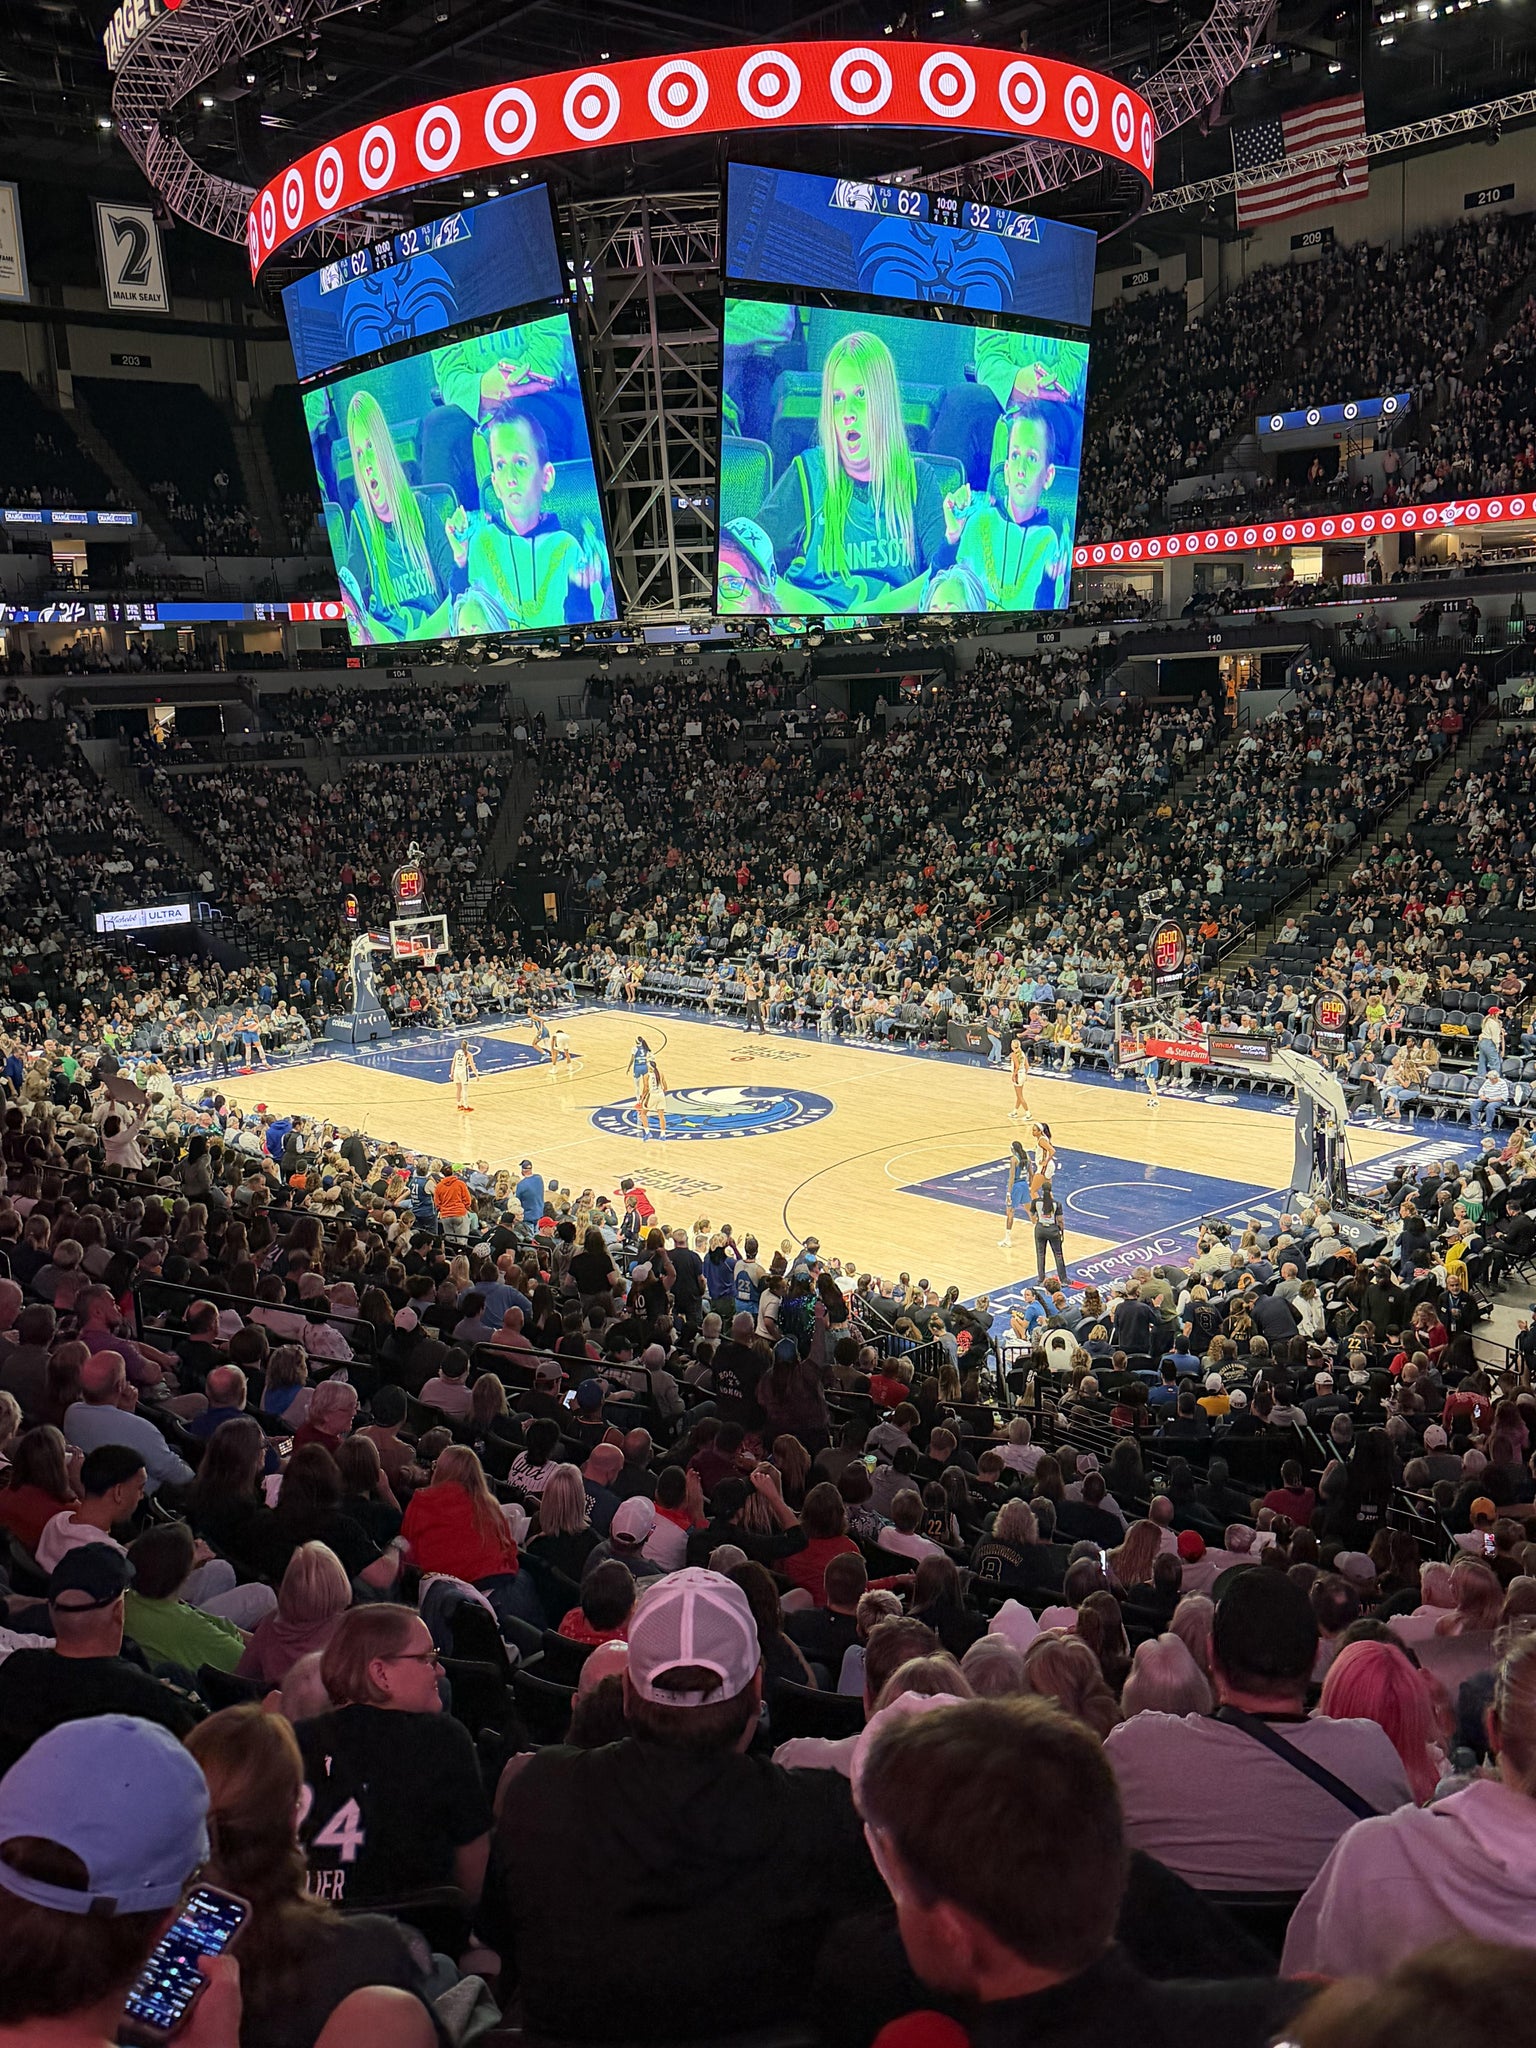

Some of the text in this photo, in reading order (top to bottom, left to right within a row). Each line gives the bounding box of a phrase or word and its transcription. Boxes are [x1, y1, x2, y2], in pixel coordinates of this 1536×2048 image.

[898, 190, 921, 216] 62
[1478, 188, 1500, 205] 210
[936, 197, 957, 211] 10:00
[943, 216, 948, 226] 3
[970, 203, 990, 228] 32
[400, 230, 420, 256] 32
[1302, 231, 1322, 246] 209
[107, 213, 152, 286] 2
[351, 250, 368, 275] 62
[1132, 270, 1149, 285] 208
[113, 291, 161, 302] MALIK SEALY
[121, 355, 140, 366] 203
[1443, 602, 1458, 612] 111
[1042, 633, 1055, 642] 109
[1207, 634, 1222, 644] 110
[392, 670, 406, 678] 104
[401, 872, 418, 881] 10:00
[400, 881, 418, 896] 24
[148, 909, 182, 920] ULTRA
[1158, 930, 1178, 945] 10:00
[1156, 943, 1176, 967] 24
[1164, 973, 1183, 982] TISSOT
[1322, 1001, 1343, 1013] 10:00
[1322, 1011, 1340, 1025] 24
[1174, 1047, 1208, 1059] State Farm
[635, 1167, 724, 1193] CENTER
[411, 1183, 419, 1195] 21
[1076, 1238, 1183, 1279] Michelob
[737, 1279, 751, 1292] 23
[1348, 1337, 1361, 1349] 22
[927, 1520, 942, 1535] 22
